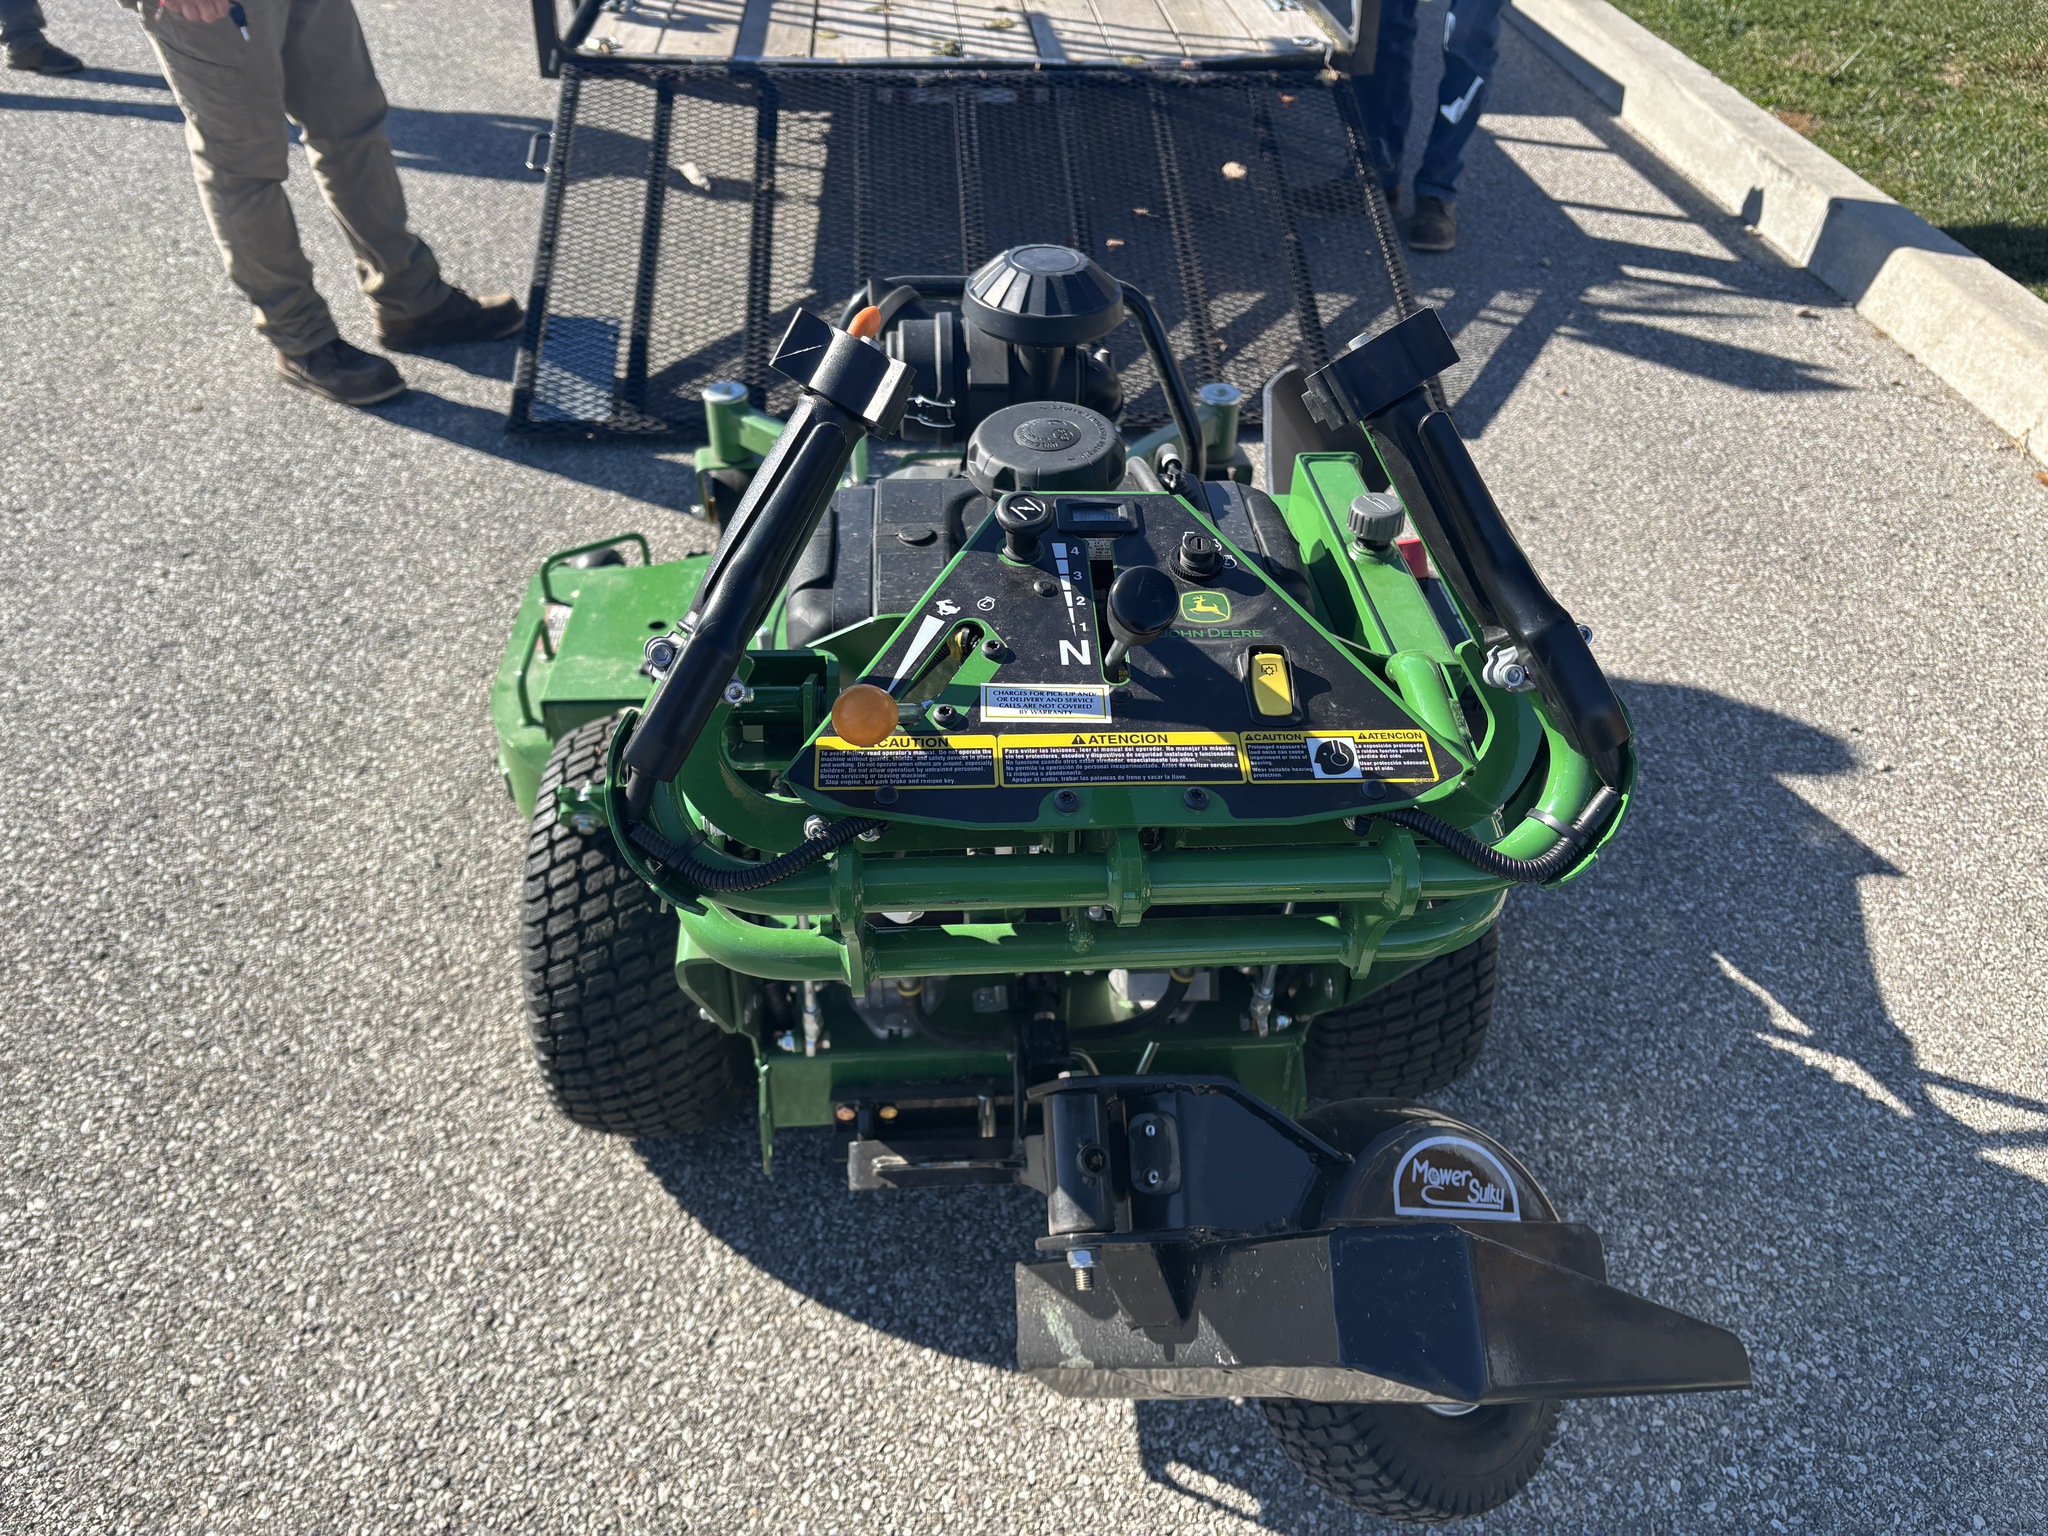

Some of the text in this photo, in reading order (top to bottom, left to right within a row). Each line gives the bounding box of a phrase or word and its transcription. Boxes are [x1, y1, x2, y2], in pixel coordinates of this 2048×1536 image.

[1070, 546, 1080, 556] 4
[1073, 571, 1082, 580] 3
[1075, 596, 1086, 606] 2
[1079, 622, 1087, 632] 1
[1160, 627, 1263, 638] JOHN DEERE
[1059, 639, 1091, 666] N
[1088, 734, 1168, 744] ATENCION
[1254, 733, 1302, 741] CAUTION
[1368, 732, 1422, 740] ATENCION
[1411, 1158, 1473, 1187] Mower
[1467, 1178, 1505, 1211] Sulky
